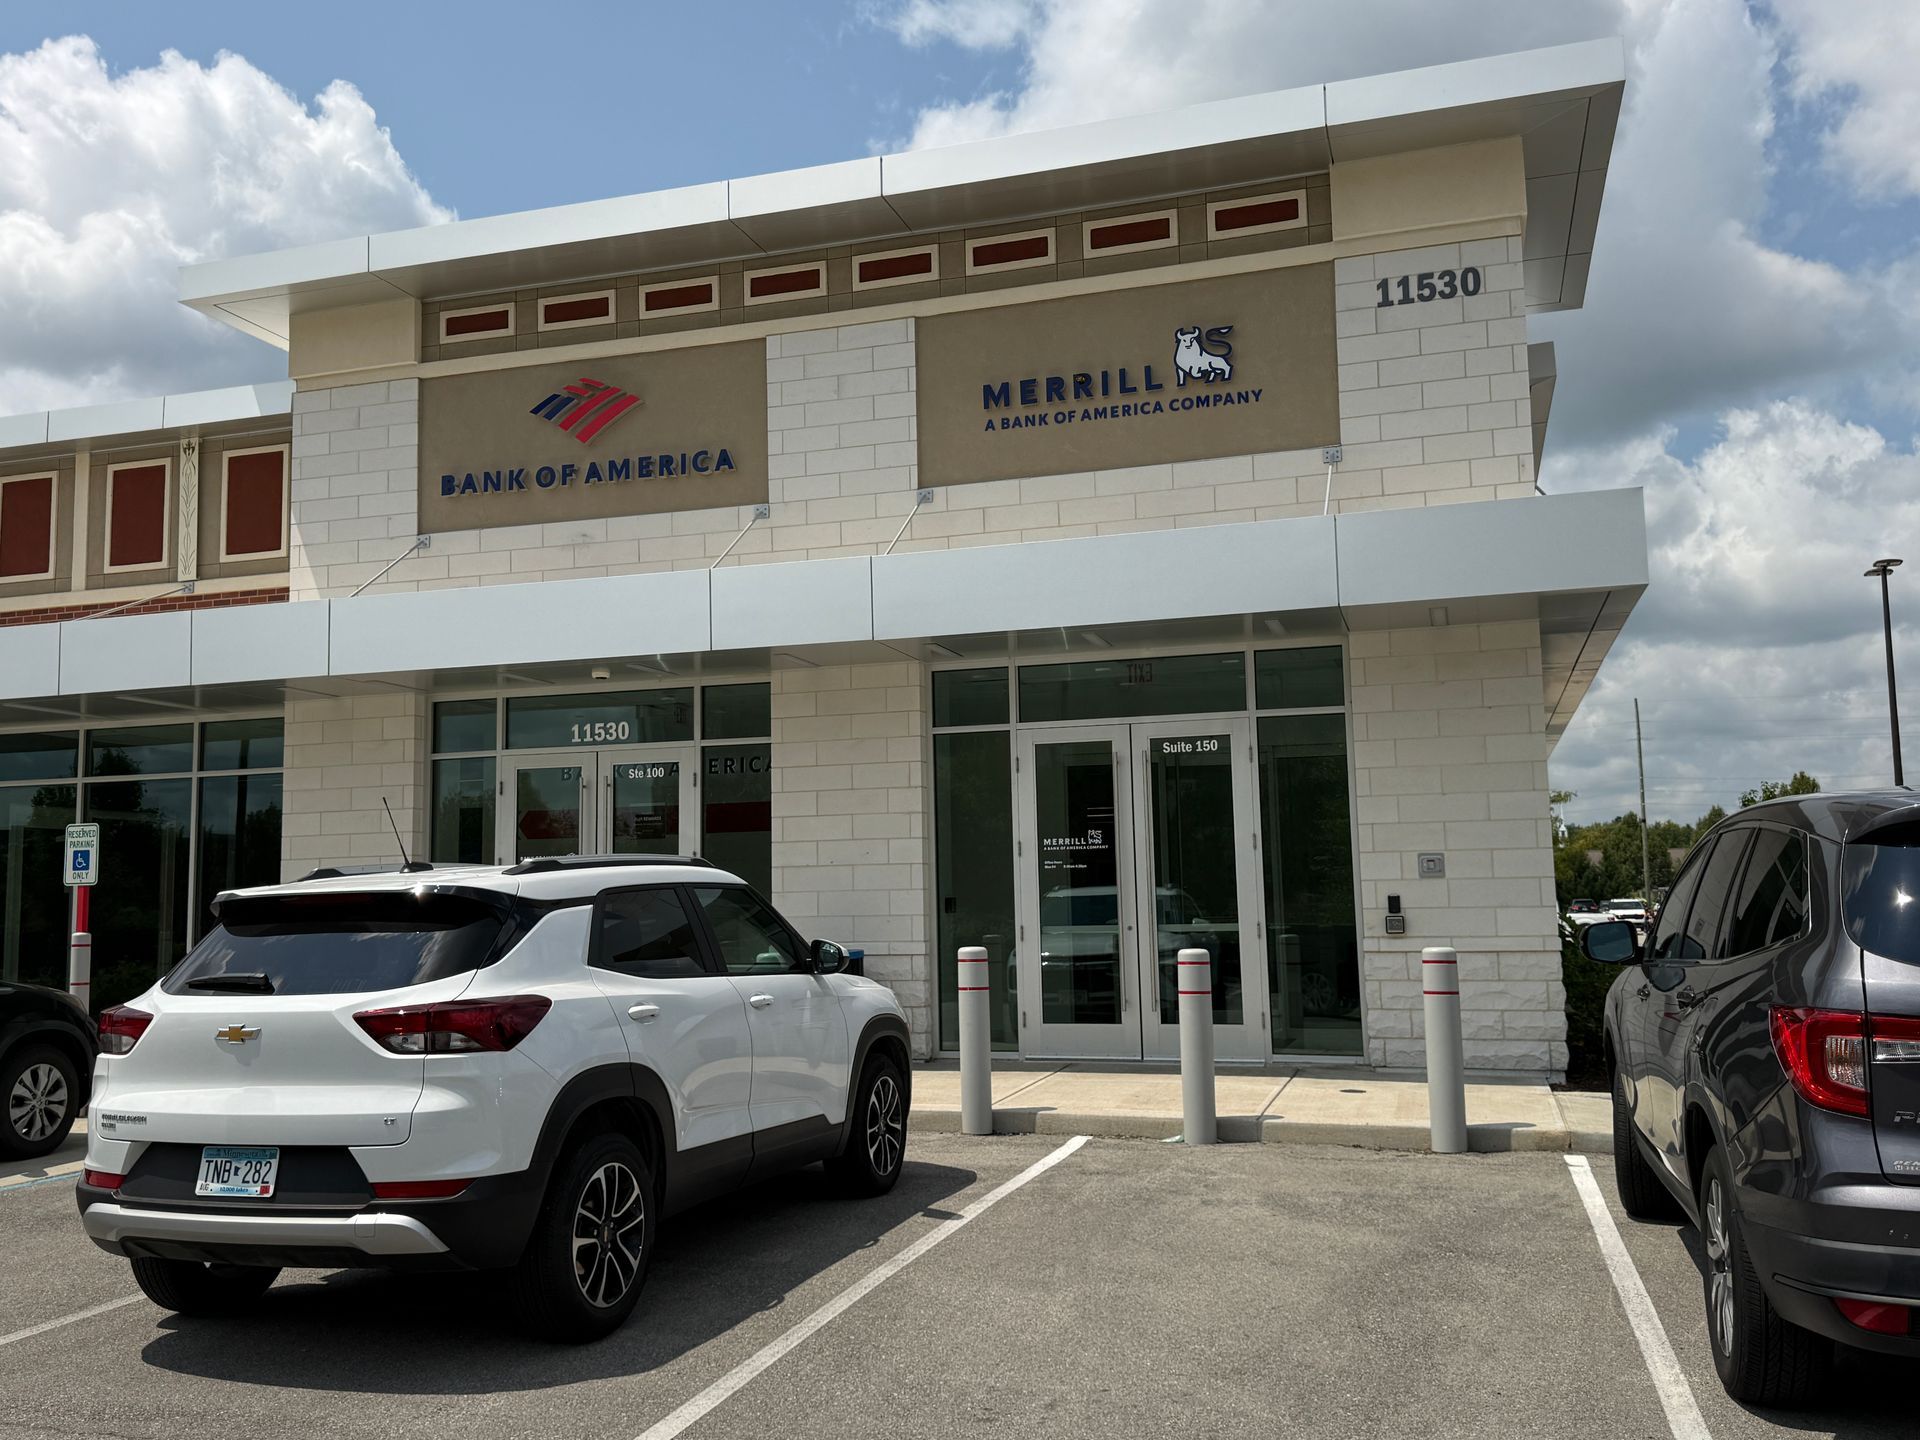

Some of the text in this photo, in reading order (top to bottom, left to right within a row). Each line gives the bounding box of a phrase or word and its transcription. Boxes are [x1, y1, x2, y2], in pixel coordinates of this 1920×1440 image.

[1376, 266, 1481, 308] 11530
[982, 365, 1163, 410] MERRILL
[984, 389, 1263, 431] A BANK OF AMERICA COMPANY
[441, 448, 736, 497] BANK OF AMERICA
[571, 721, 630, 743] 11530
[1162, 739, 1218, 753] Suite 150
[628, 768, 644, 779] Ste
[646, 766, 665, 778] 100
[68, 829, 96, 839] RESERVED
[1043, 837, 1087, 846] MERRILL
[69, 840, 95, 848] PARKING
[72, 872, 89, 880] ONLY
[204, 1159, 273, 1185] TNB 282
